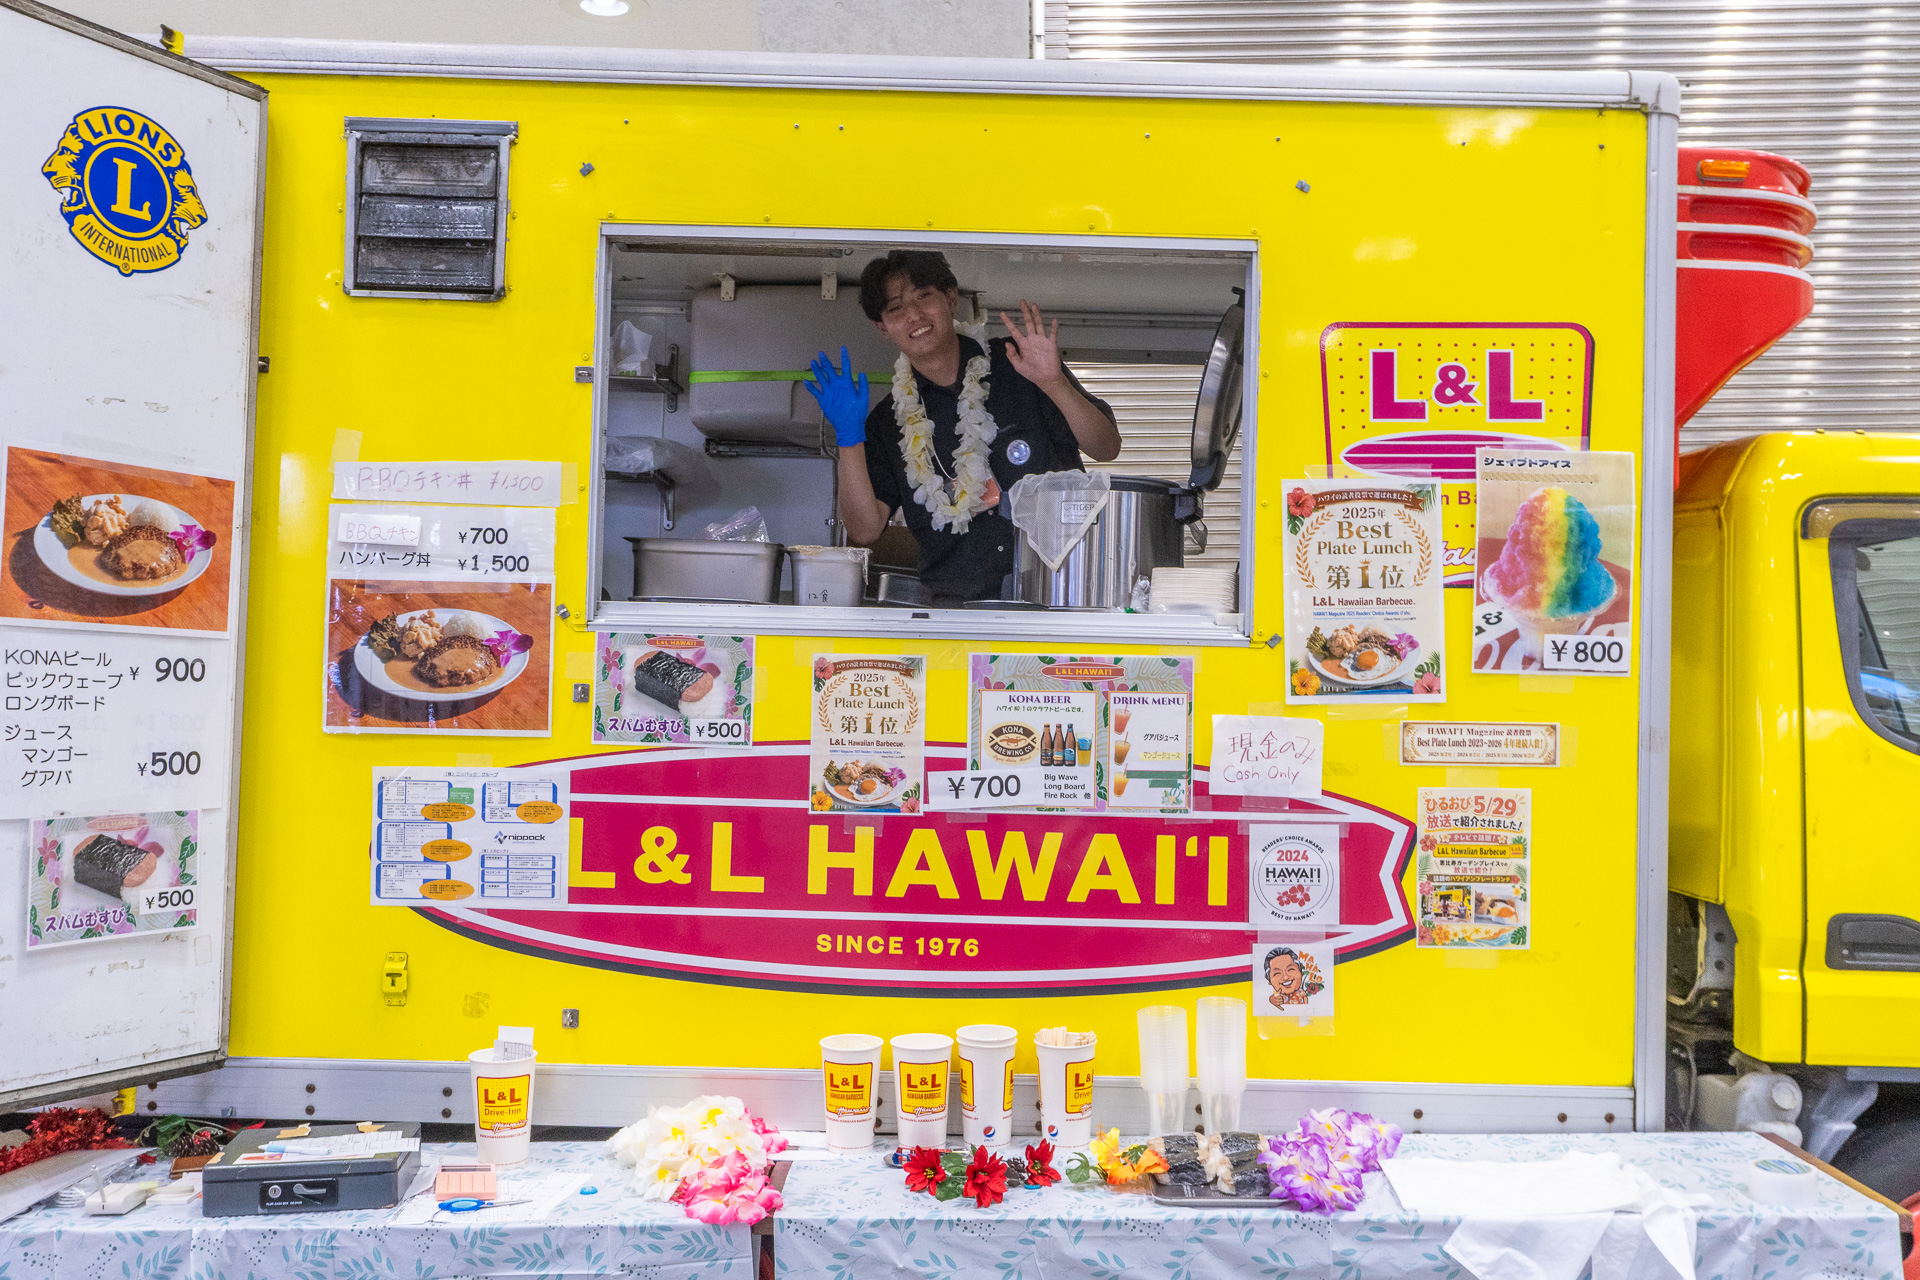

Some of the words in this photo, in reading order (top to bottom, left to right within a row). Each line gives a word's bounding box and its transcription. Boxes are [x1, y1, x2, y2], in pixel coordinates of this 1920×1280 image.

[83, 112, 177, 163] LIONS
[111, 157, 151, 222] L
[80, 221, 172, 264] INTERNATIONAL
[1369, 349, 1545, 423] L&L
[1342, 507, 1386, 519] 2025年
[458, 527, 508, 545] ¥700
[1336, 521, 1393, 540] Best
[1317, 540, 1357, 555] Plate
[1363, 540, 1413, 555] Lunch
[339, 551, 431, 568] ハンバーグ丼
[458, 554, 530, 575] ¥1,500
[1326, 564, 1405, 590] 第1位
[1312, 596, 1336, 607] L&L
[1338, 597, 1374, 606] Hawaiian
[1376, 597, 1416, 606] Barbecue.
[5, 649, 112, 668] KONAビール
[1551, 640, 1624, 663] ¥800
[6, 672, 123, 689] ビックウェーブ
[849, 683, 891, 697] Best
[5, 695, 105, 711] ロングボード
[834, 697, 864, 709] Plate
[868, 698, 905, 709] Lunch
[1008, 695, 1041, 703] KONA
[1043, 695, 1071, 704] BEER
[1113, 696, 1149, 705] DRINK
[1151, 697, 1185, 706] MENU
[5, 724, 73, 741] ジュース
[608, 718, 682, 733] スパムむすび
[696, 722, 742, 738] ¥500
[840, 715, 898, 735] 第1位
[1002, 726, 1023, 734] KONA
[1467, 728, 1504, 737] Magazine
[829, 738, 846, 746] L&L
[1227, 730, 1316, 766] 現金のみ
[1417, 737, 1430, 747] Best
[1431, 738, 1447, 747] Plate
[1448, 738, 1467, 748] Lunch
[22, 746, 88, 763] マンゴー
[993, 744, 1024, 757] BREWING
[21, 770, 72, 787] グアバ
[1044, 774, 1055, 782] Big
[1223, 765, 1260, 783] Cash
[1267, 765, 1301, 785] Only
[948, 775, 1021, 799] ¥700
[1044, 783, 1061, 791] Long
[1425, 797, 1471, 812] ひるおび
[1474, 795, 1517, 817] 5/29
[1427, 814, 1523, 831] 放送で紹介されました!
[509, 833, 545, 841] nippack
[1305, 838, 1325, 854] AWARDS
[1437, 847, 1449, 855] L&L
[1479, 848, 1507, 856] Barbecue
[567, 817, 765, 894] L&L
[1276, 849, 1309, 862] 2024
[146, 888, 194, 909] ¥500
[45, 907, 126, 932] スパムむすび
[1271, 910, 1284, 920] BEST
[816, 933, 904, 955] SINCE
[915, 936, 981, 957] 1976
[830, 1073, 864, 1089] L&L
[907, 1073, 941, 1089] L&L
[484, 1088, 521, 1104] L&L
[485, 1108, 521, 1116] Drive-Inn
